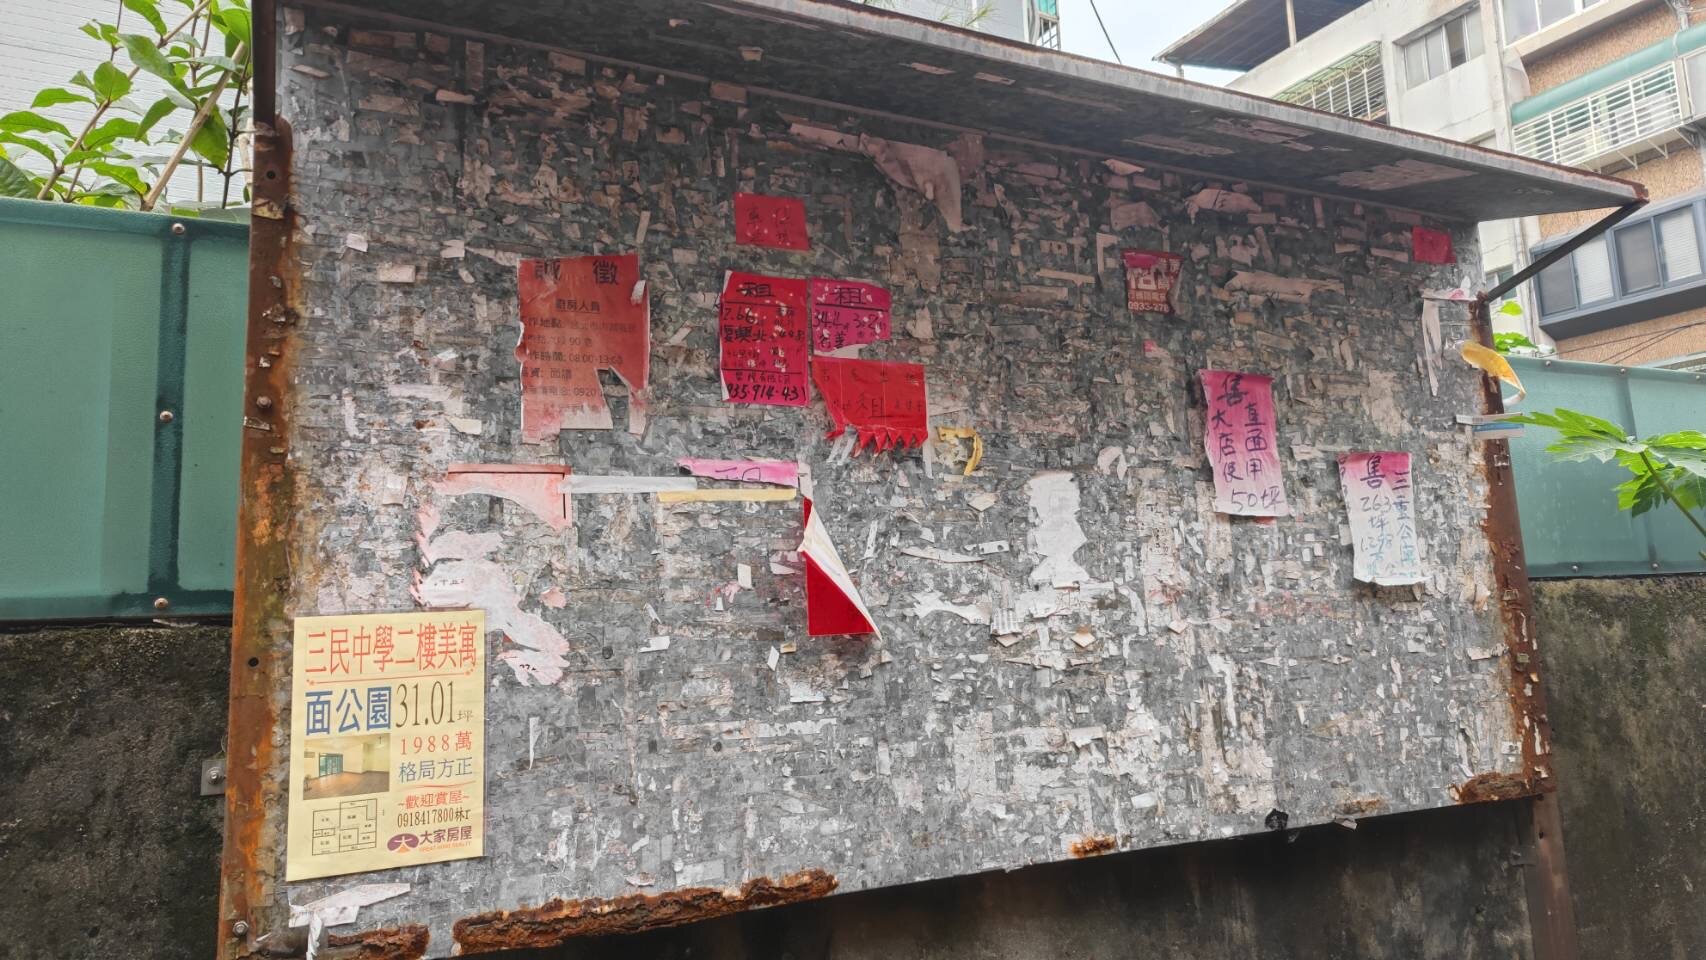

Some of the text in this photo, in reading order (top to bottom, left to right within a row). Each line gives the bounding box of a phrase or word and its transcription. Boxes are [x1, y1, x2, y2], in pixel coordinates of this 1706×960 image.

[305, 621, 478, 675] 三民中學二樓美寓
[305, 686, 392, 736] 面公園
[401, 731, 472, 756] 1988萬
[398, 757, 473, 783] 格局方正
[419, 826, 473, 845] 大家房屋
